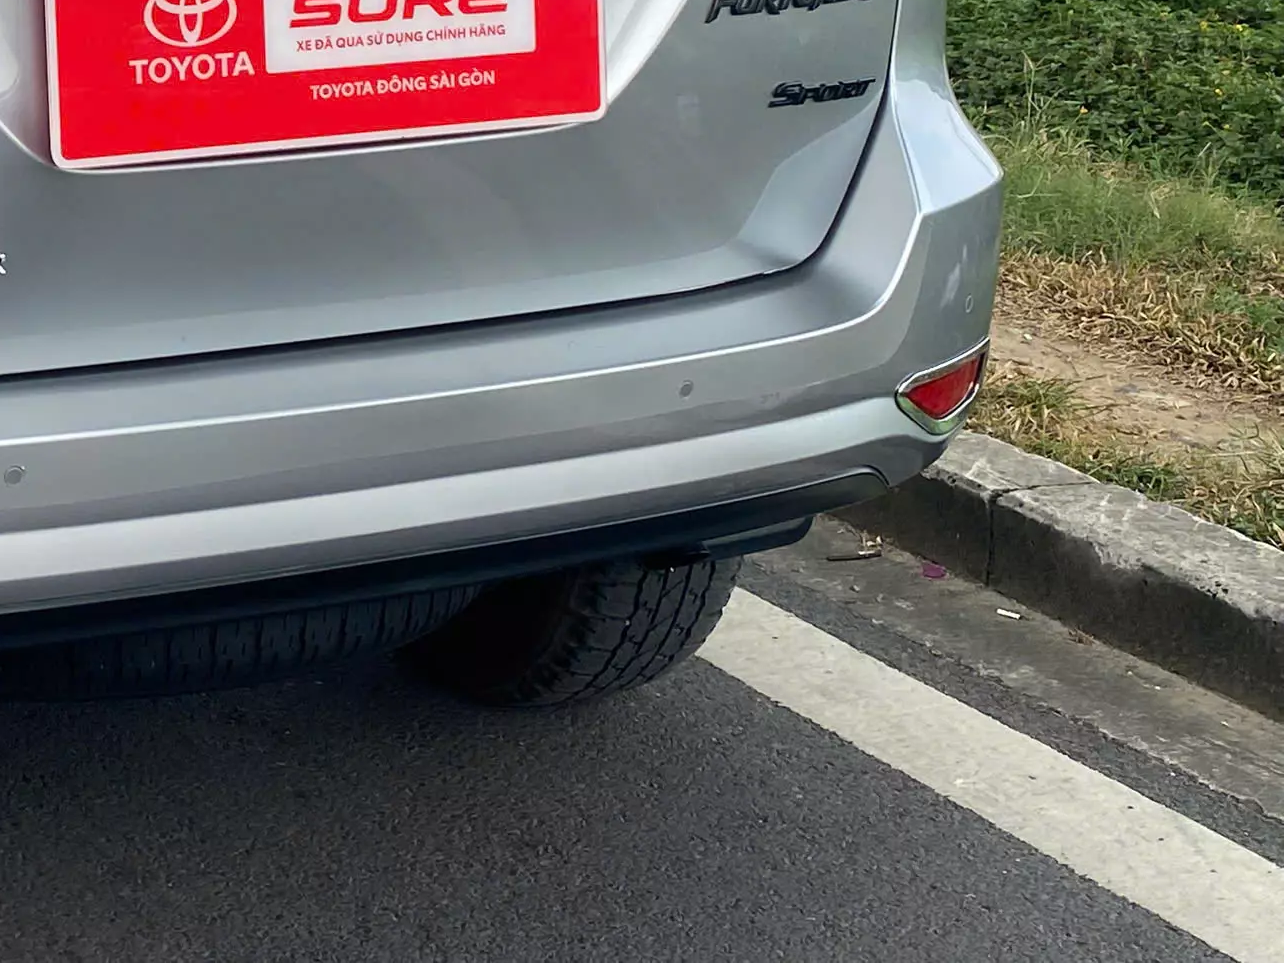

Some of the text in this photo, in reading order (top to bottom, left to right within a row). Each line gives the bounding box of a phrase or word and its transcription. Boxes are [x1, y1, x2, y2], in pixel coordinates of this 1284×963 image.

[296, 22, 506, 52] XE ĐÃ QUA SỬ DỤNG CHÍNH HÃNG
[128, 51, 255, 85] TOYOTA
[310, 68, 496, 100] TOYOTA ĐÔNG SÀI GÒN
